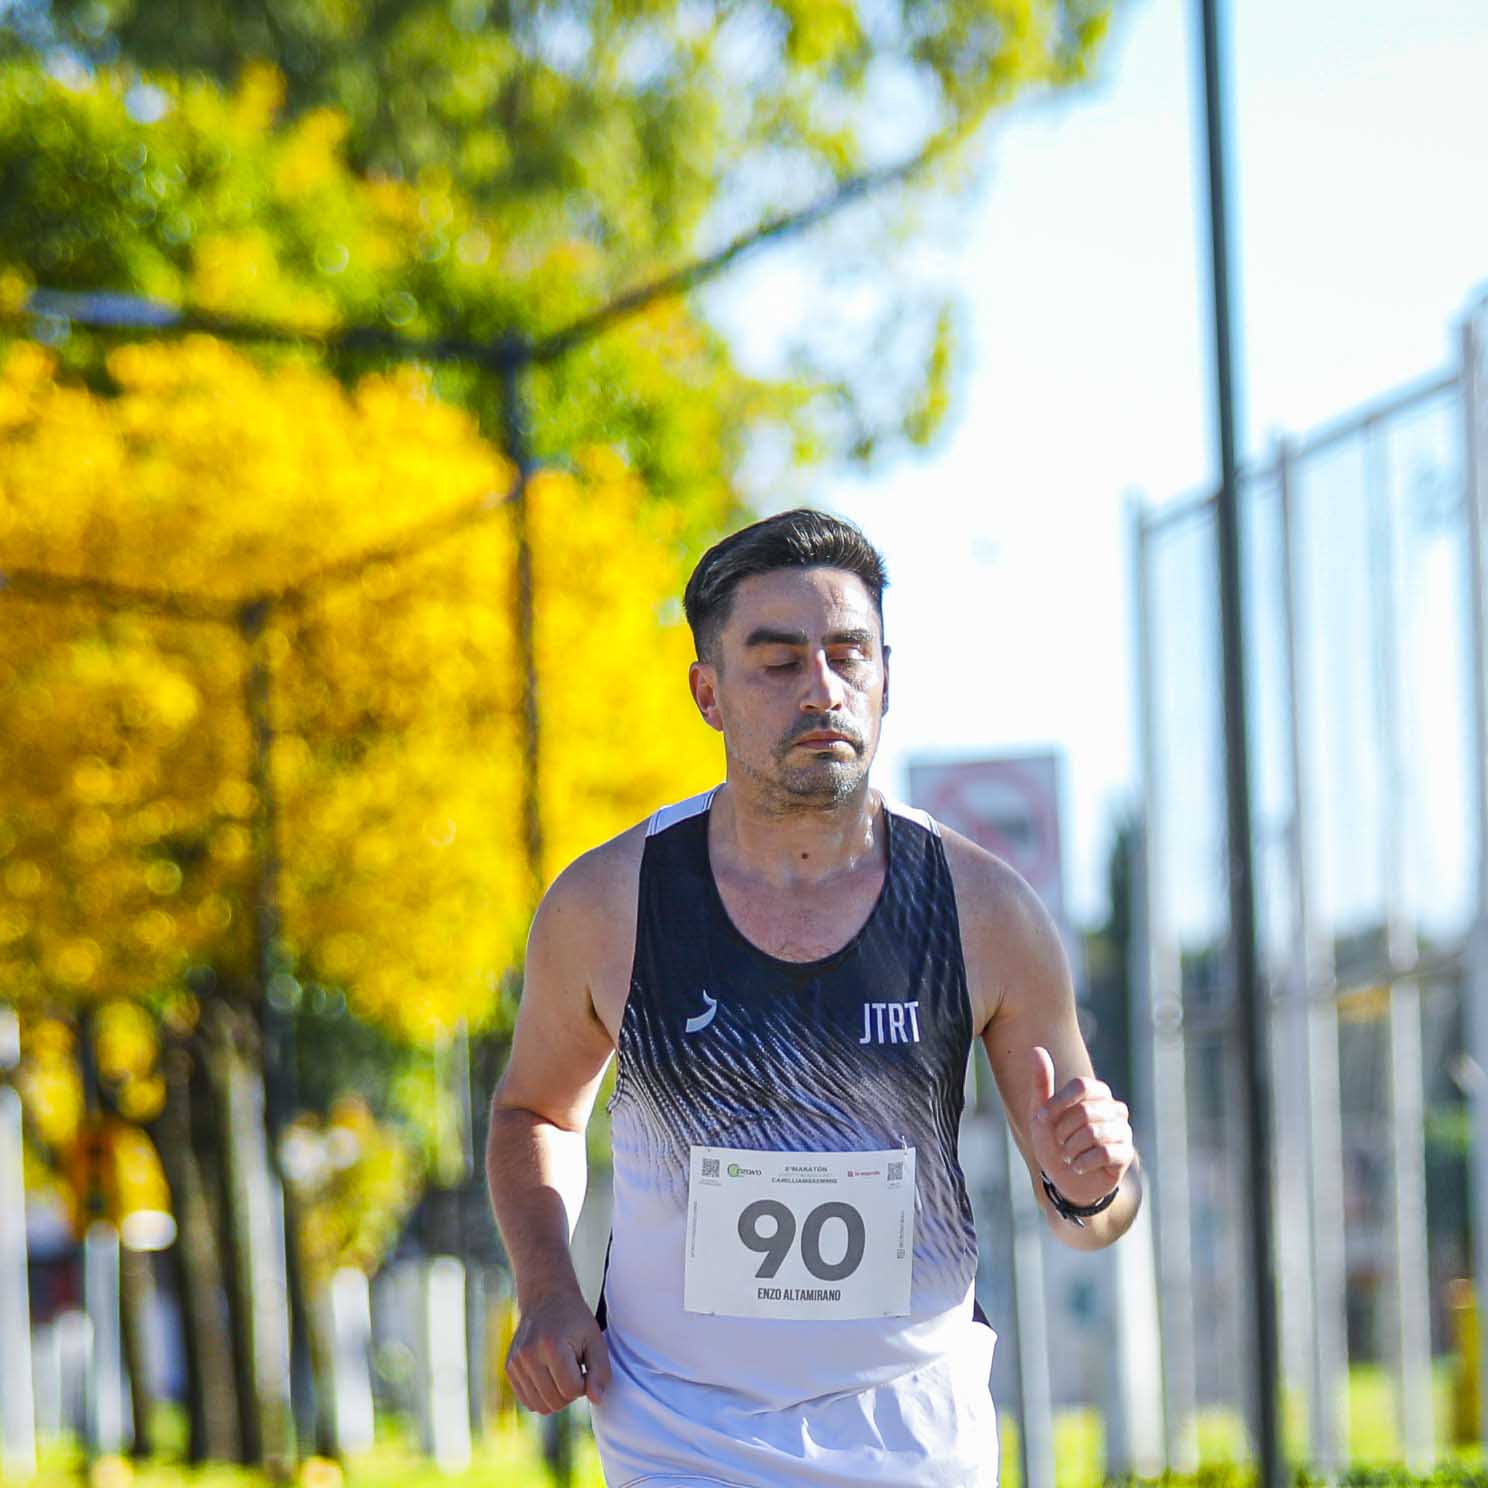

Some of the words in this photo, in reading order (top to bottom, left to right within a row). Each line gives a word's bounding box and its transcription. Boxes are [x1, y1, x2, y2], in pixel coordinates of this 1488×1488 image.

[859, 1001, 920, 1044] JTRT
[737, 1199, 866, 1282] 90
[757, 1287, 782, 1300] ENZO
[783, 1288, 841, 1302] ALTAMIRANO
